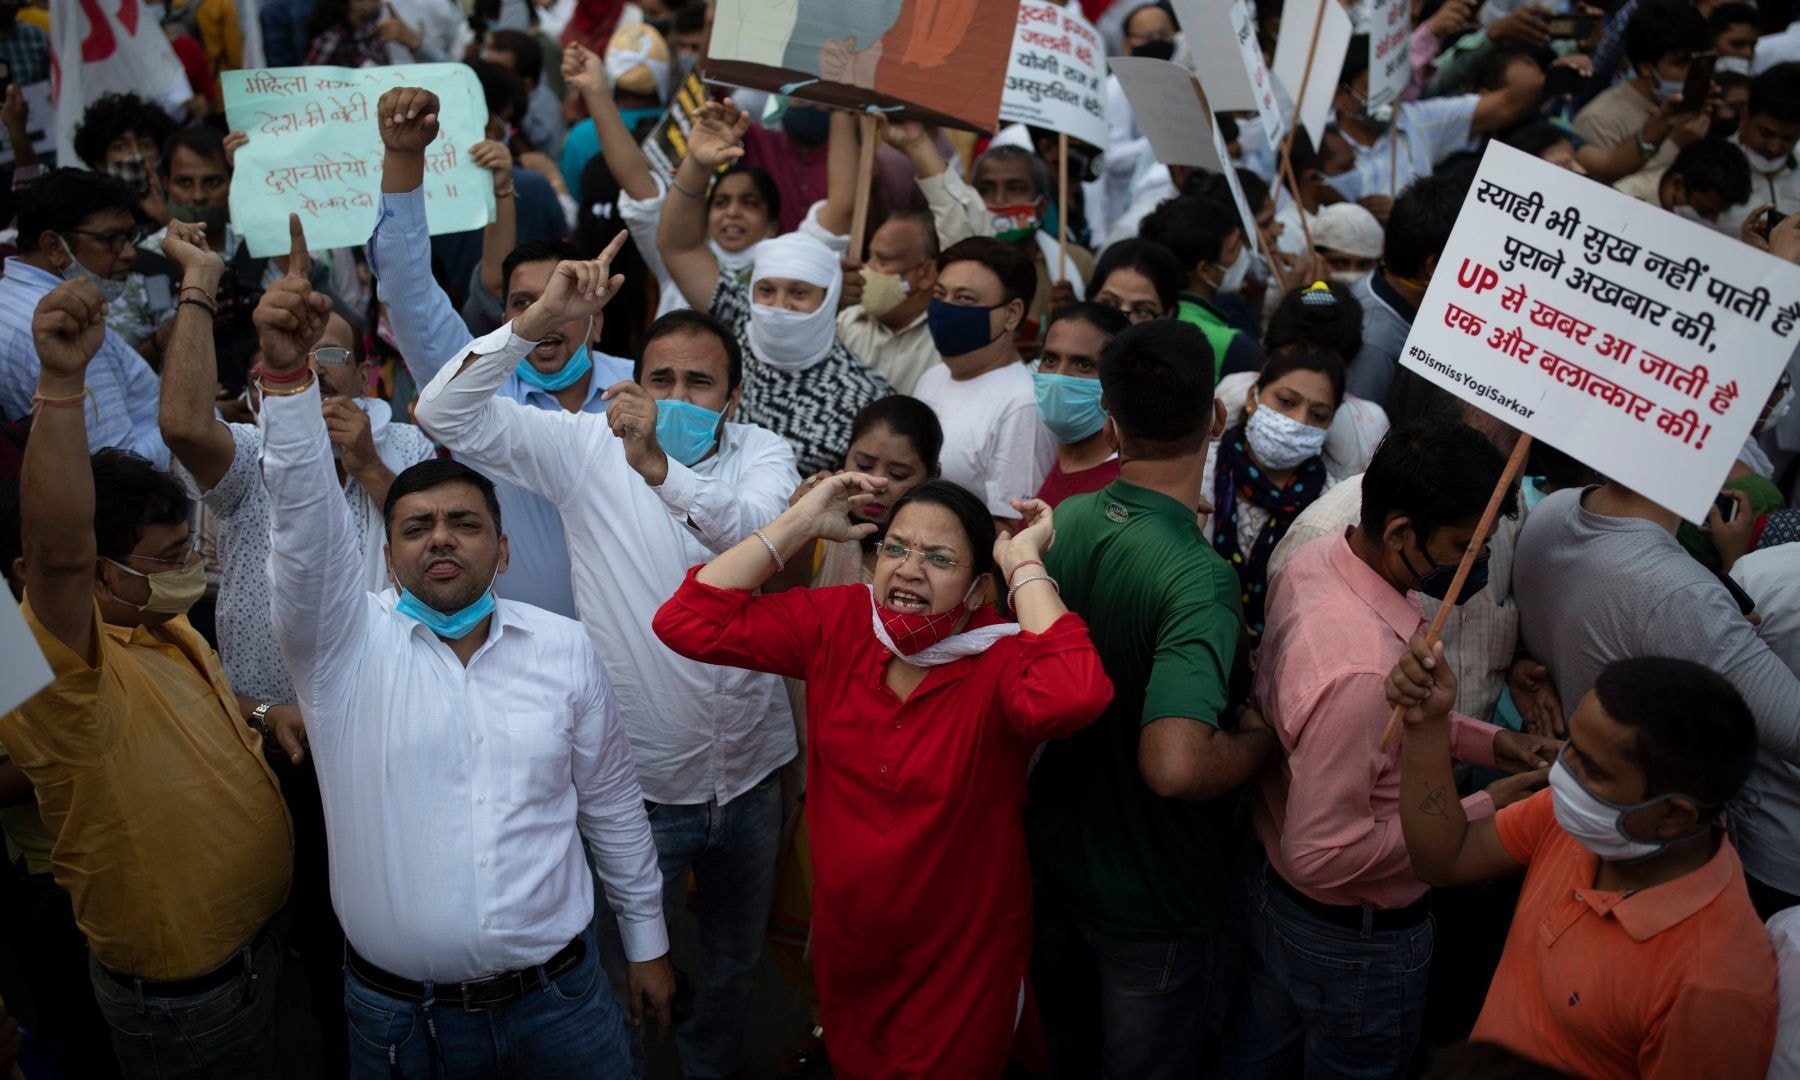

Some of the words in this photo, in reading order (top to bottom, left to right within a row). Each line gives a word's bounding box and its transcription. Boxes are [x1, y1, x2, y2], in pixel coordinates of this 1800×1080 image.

[1017, 49, 1059, 75] योगी
[1476, 179, 1544, 224] स्याही
[1545, 206, 1581, 240] भी
[1583, 225, 1642, 266] सुख
[1644, 250, 1710, 292] नहीं
[1707, 277, 1771, 322] पाती
[1771, 302, 1800, 337] है
[1499, 236, 1565, 279] पुराने
[1566, 266, 1671, 326] अखबार
[1672, 311, 1716, 353] की,
[1409, 346, 1535, 419] #DismissYogiSarkar
[1444, 303, 1487, 337] एक
[1487, 326, 1539, 364] और
[1539, 350, 1657, 422] बलात्कार
[1656, 407, 1712, 450] की!
[1457, 258, 1499, 294] UP
[1500, 284, 1528, 313] से
[1530, 300, 1596, 346] खबर
[1595, 333, 1637, 365] आ
[1640, 350, 1709, 400] जाती
[1709, 380, 1739, 415] है
